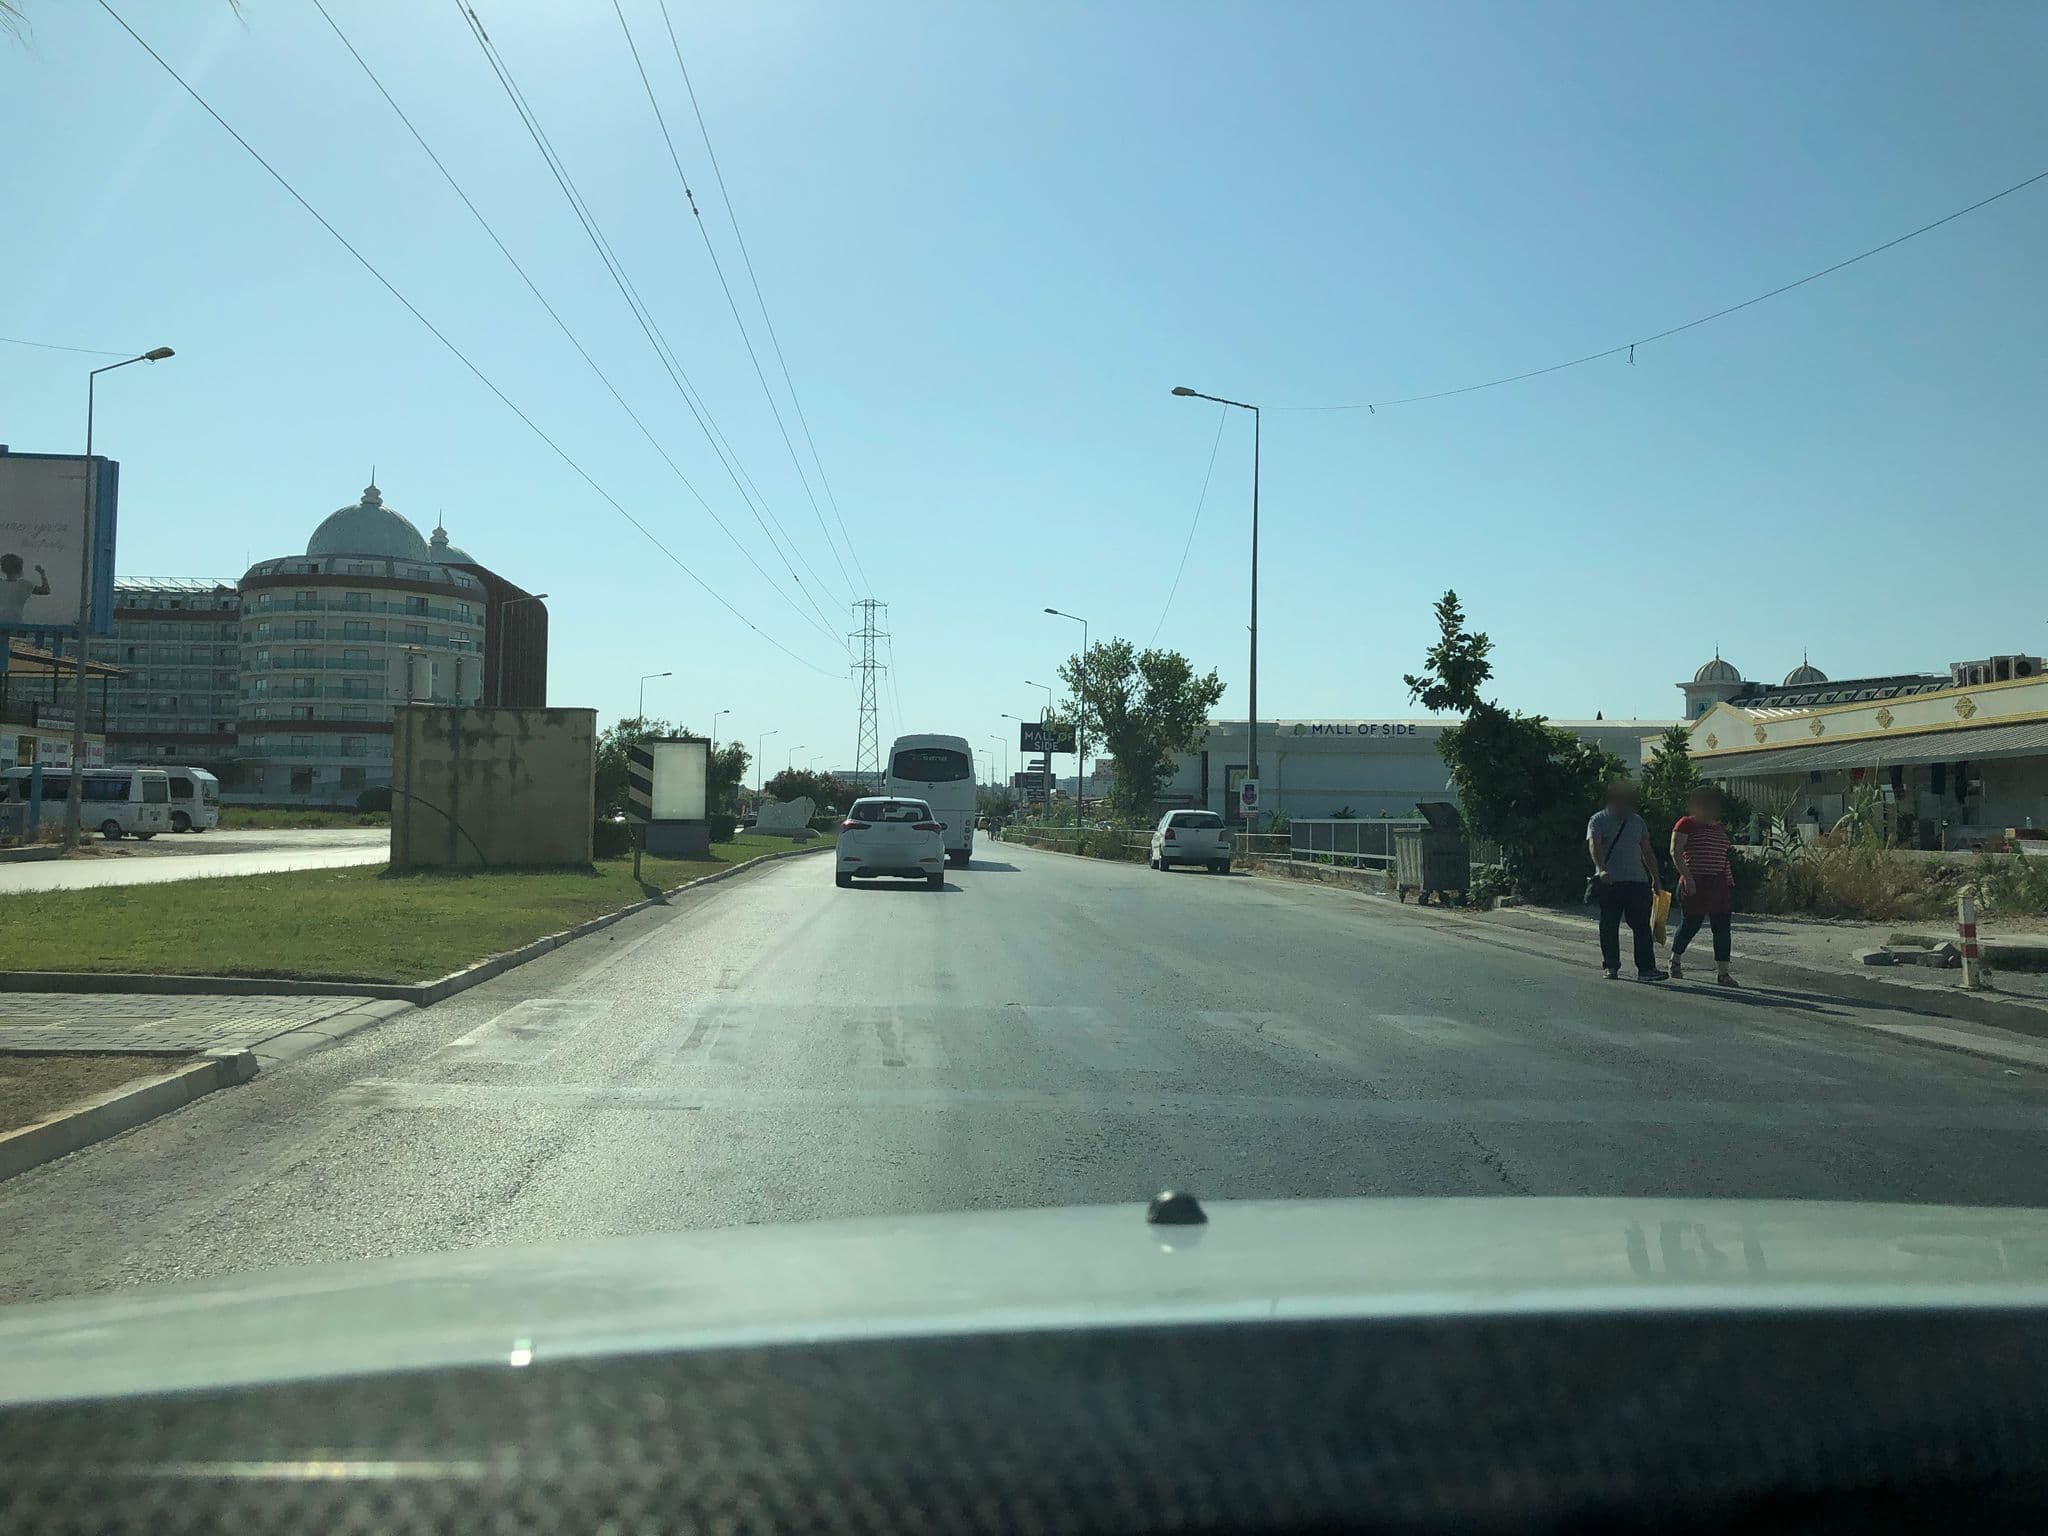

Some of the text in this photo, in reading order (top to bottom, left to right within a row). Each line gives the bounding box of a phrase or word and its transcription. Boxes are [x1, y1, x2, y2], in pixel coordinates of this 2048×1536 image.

[1312, 724, 1416, 735] MALL OF SIDE
[1034, 741, 1059, 751] SIDE
